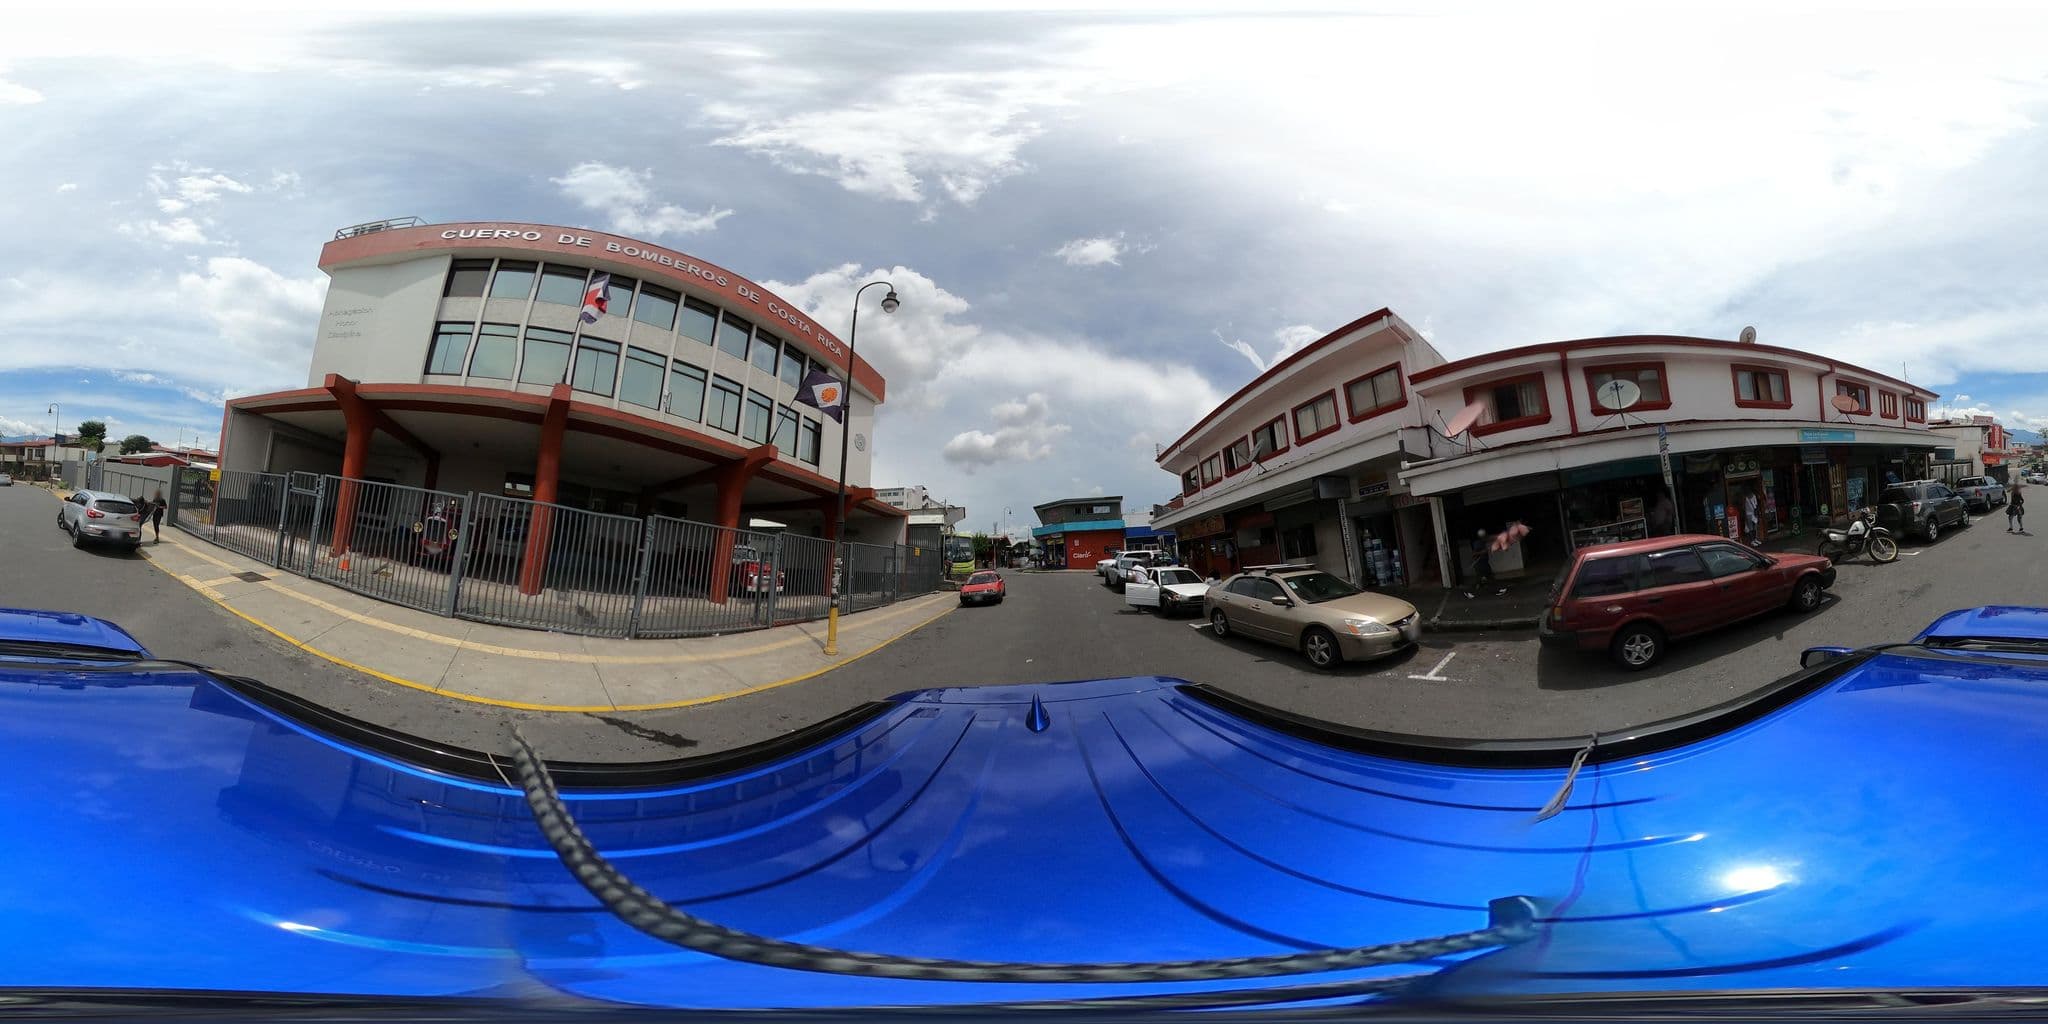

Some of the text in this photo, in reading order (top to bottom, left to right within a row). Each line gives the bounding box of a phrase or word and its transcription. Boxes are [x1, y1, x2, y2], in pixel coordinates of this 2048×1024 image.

[440, 229, 843, 358] CUERPO DE BOMBEROS DE COSTA RICA
[1072, 551, 1090, 559] Claro
